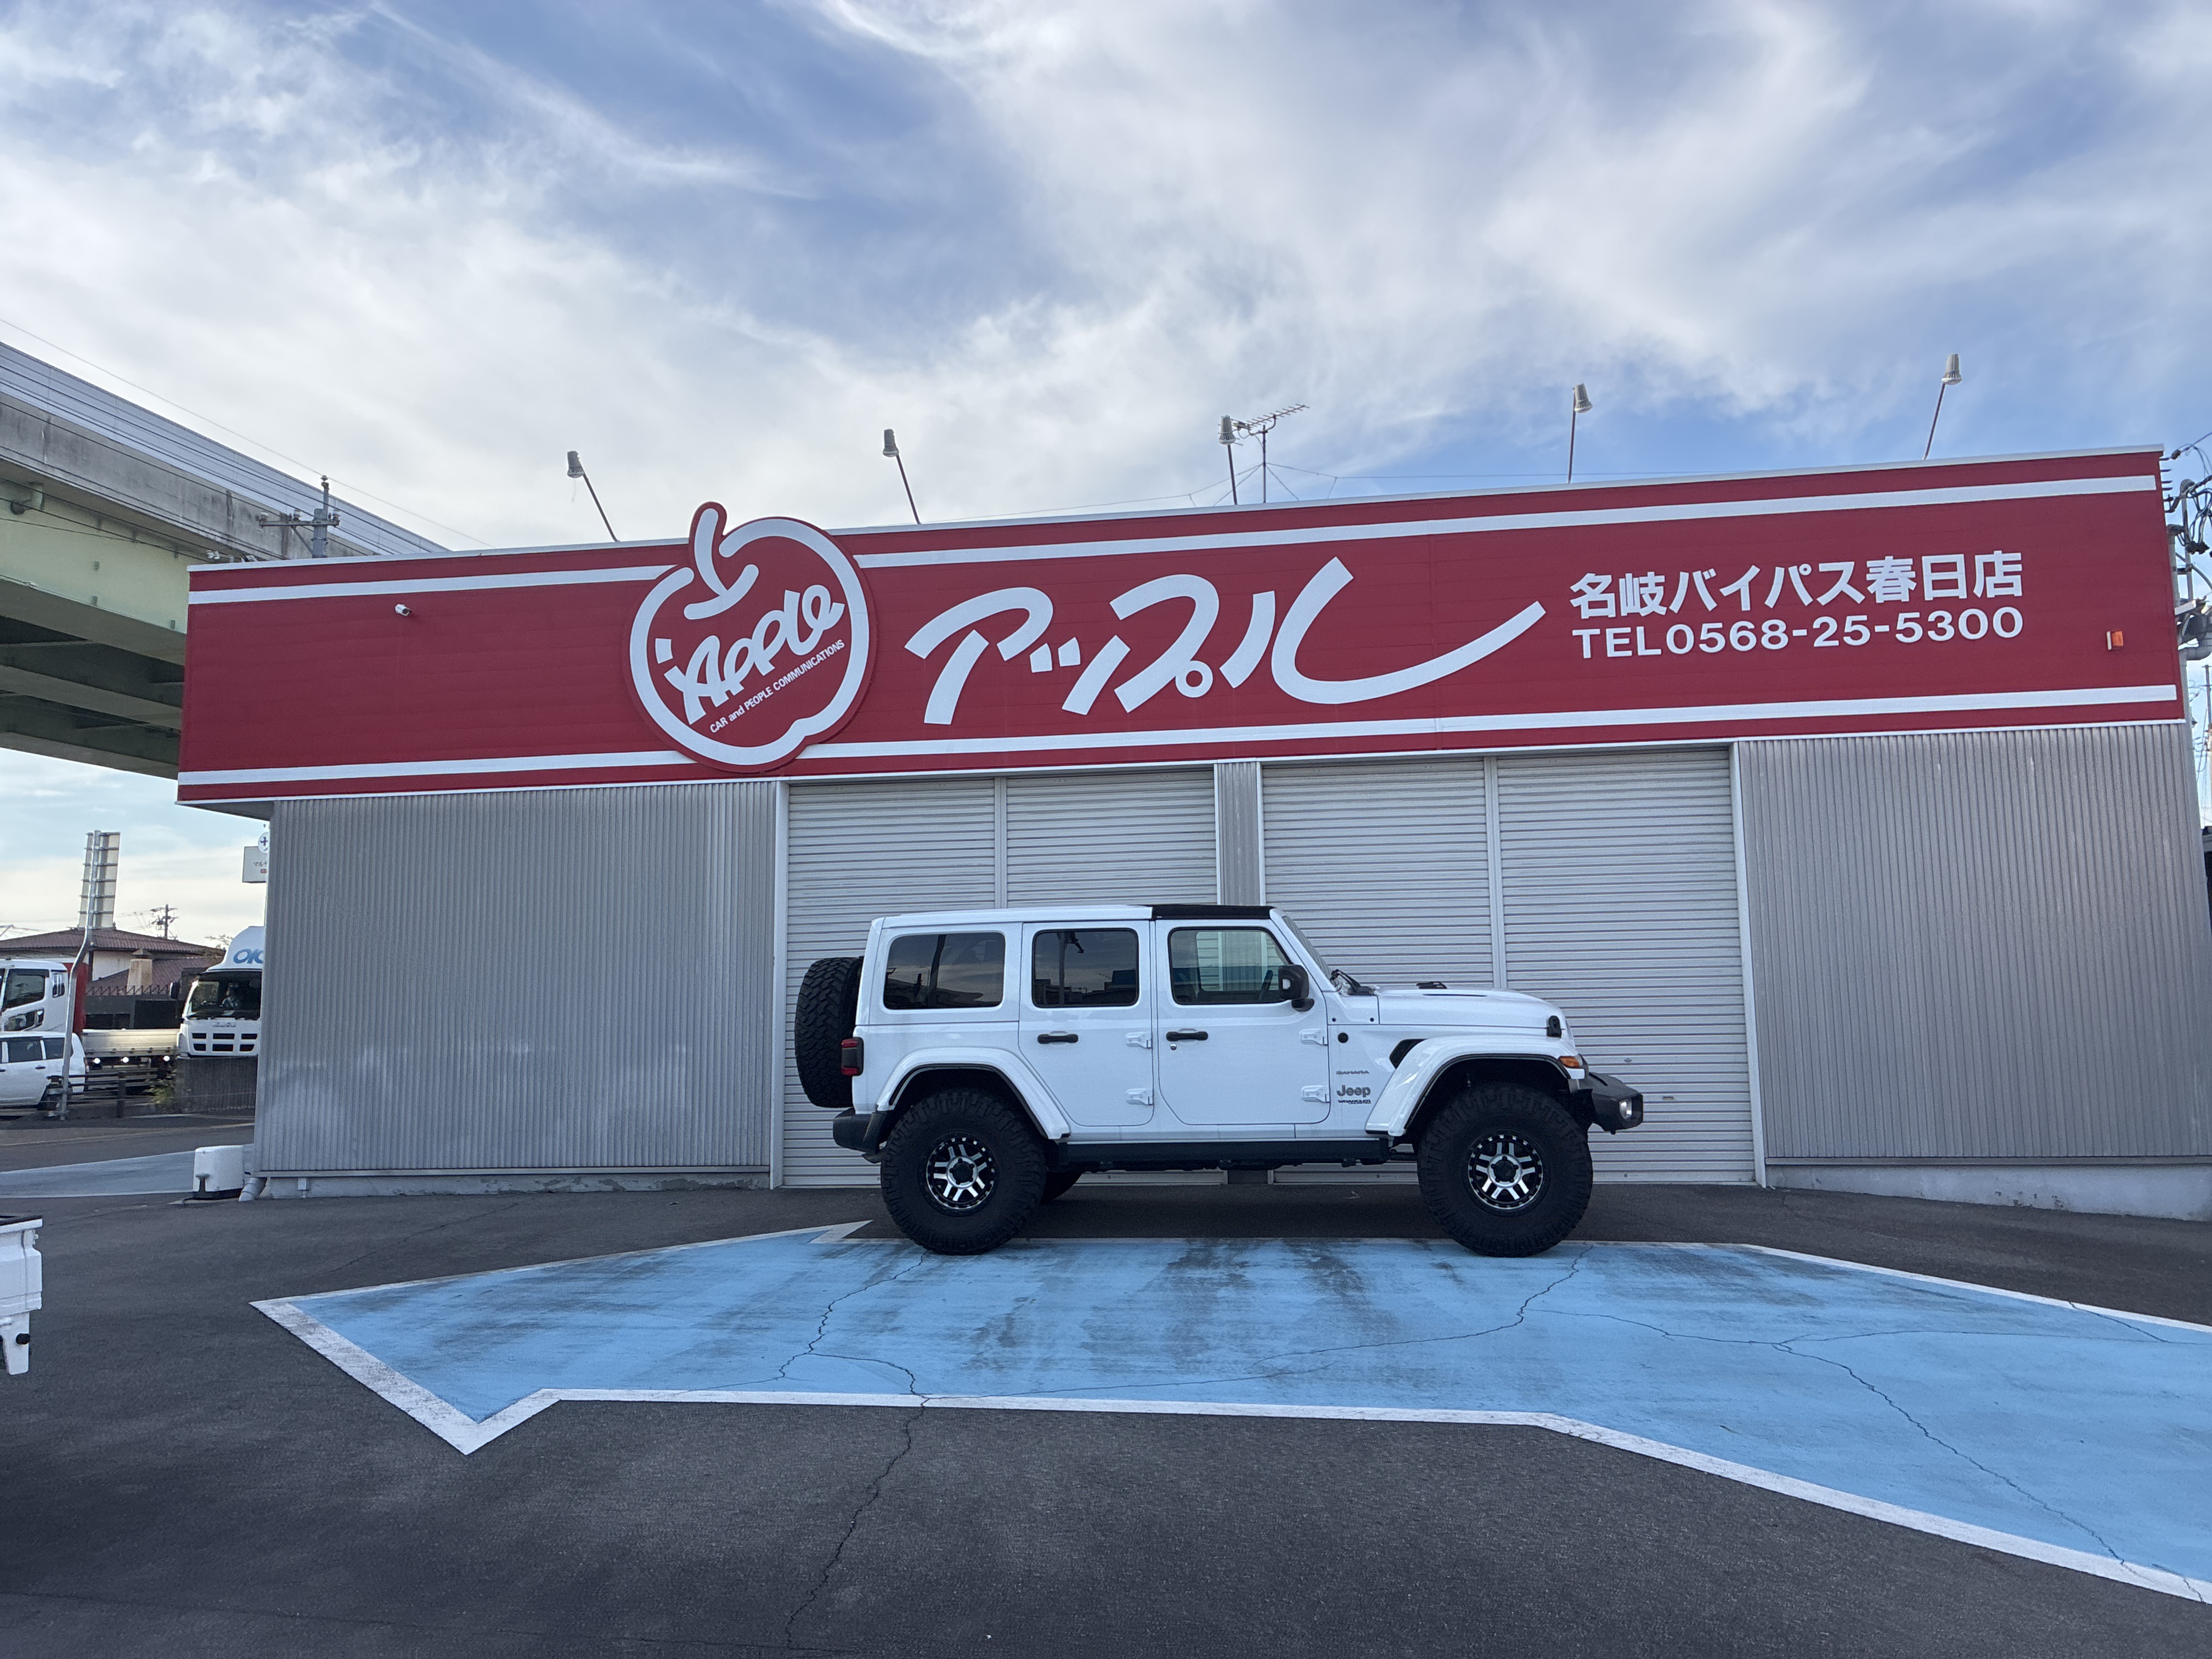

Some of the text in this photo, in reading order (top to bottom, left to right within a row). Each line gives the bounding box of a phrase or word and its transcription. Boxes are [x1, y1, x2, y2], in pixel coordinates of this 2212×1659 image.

[1569, 550, 2023, 620] 名岐バイパス春日店
[654, 584, 845, 725] Apple
[709, 639, 845, 733] CAR and PEOPLE COMMUNICATIONS
[904, 556, 1547, 726] アップル
[1336, 1085, 1370, 1098] Jeep
